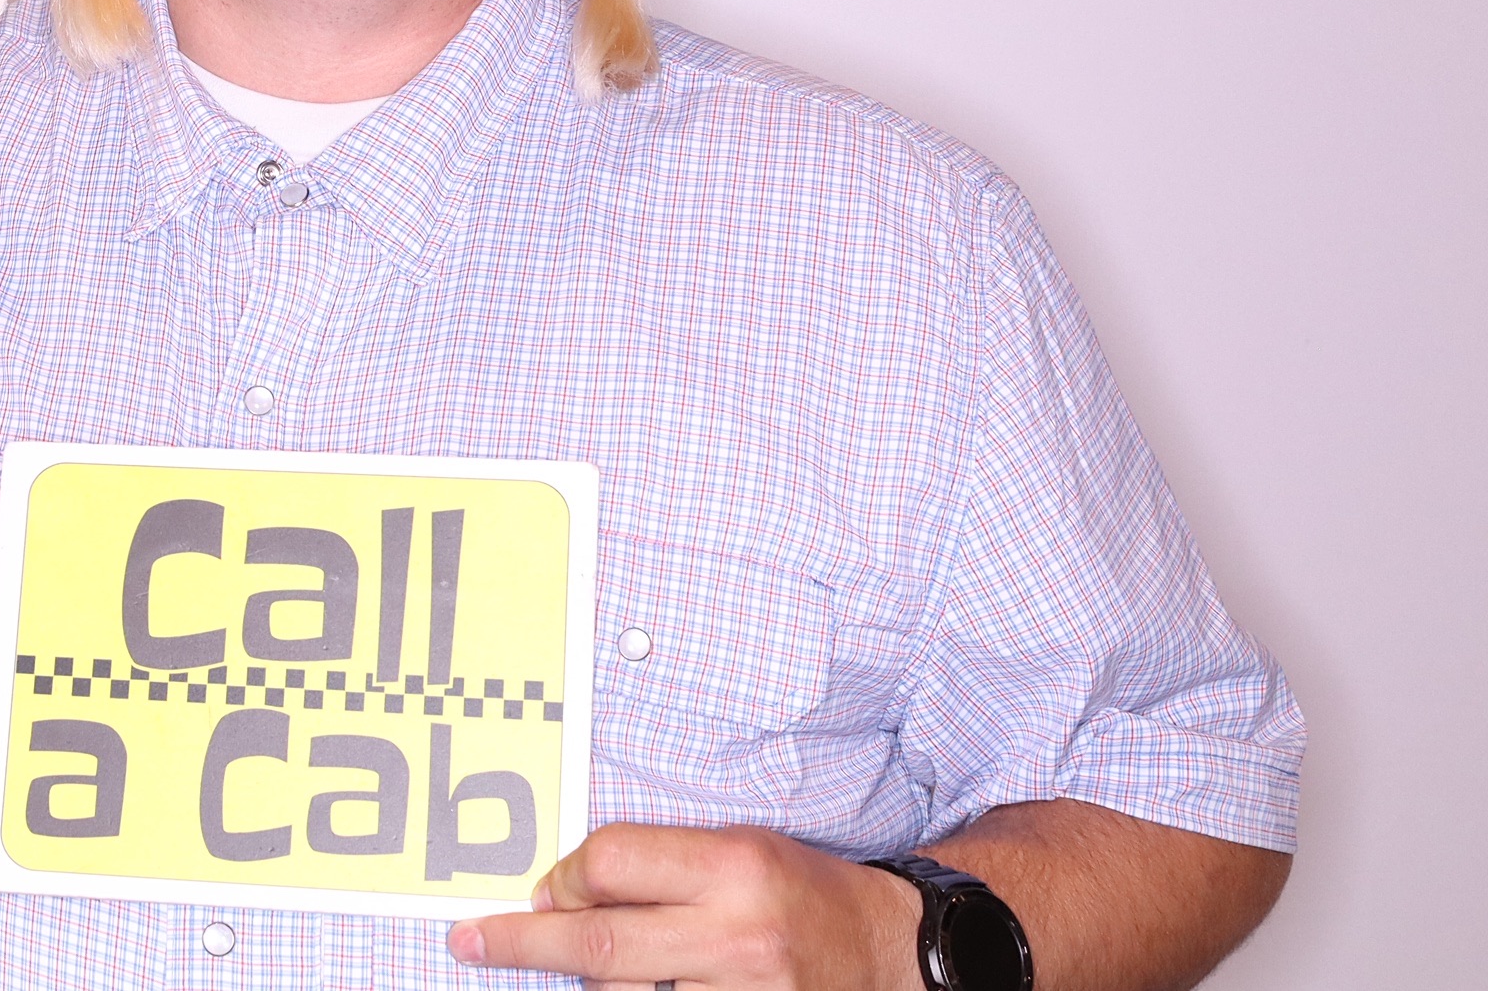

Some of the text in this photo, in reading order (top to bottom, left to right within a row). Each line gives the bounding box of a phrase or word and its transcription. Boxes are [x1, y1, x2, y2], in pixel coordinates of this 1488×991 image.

[122, 499, 465, 685] Call
[25, 708, 538, 881] a Cab
